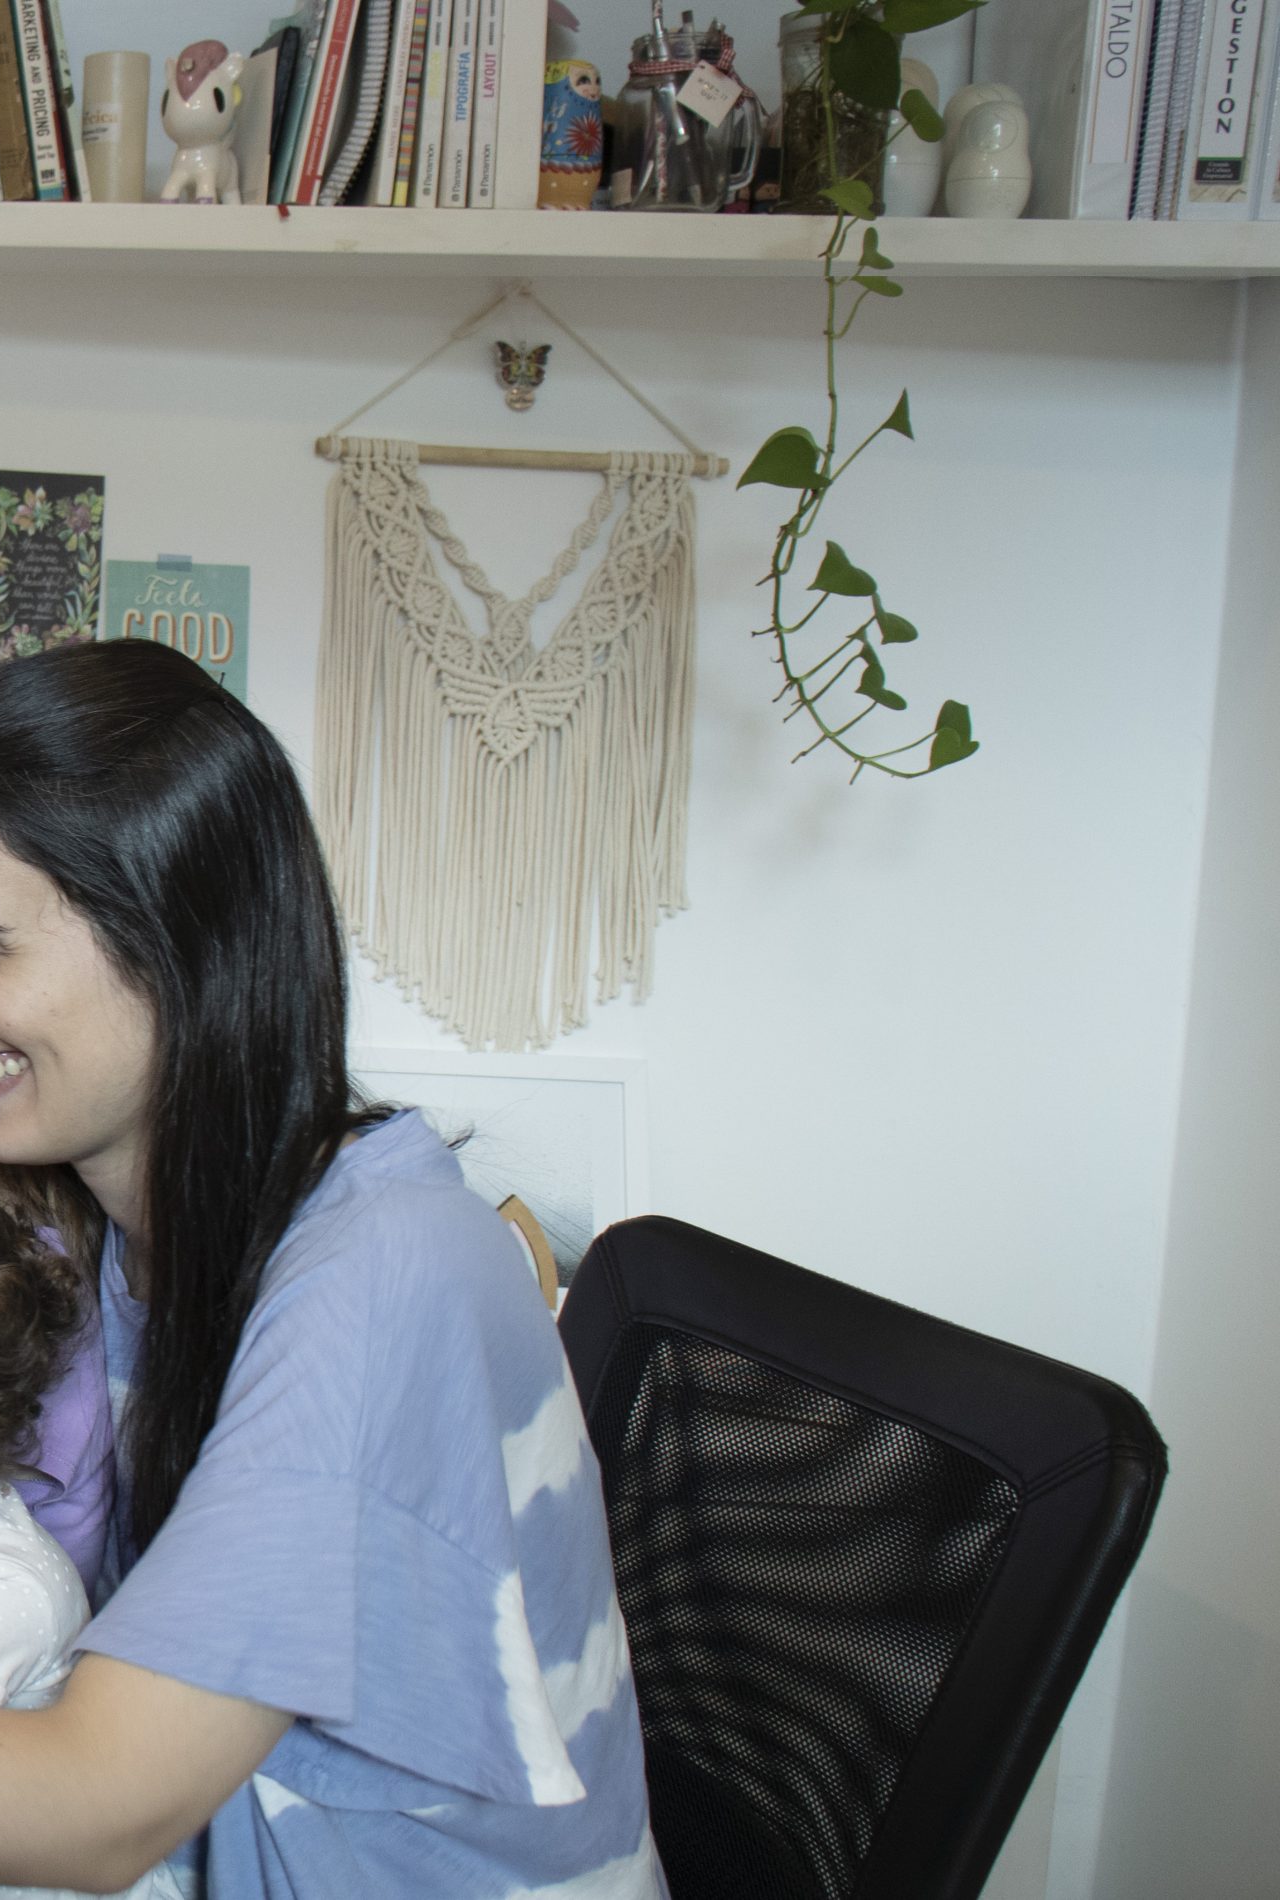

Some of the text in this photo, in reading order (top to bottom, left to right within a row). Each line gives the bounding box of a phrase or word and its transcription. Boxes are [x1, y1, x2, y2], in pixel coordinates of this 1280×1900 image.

[30, 66, 42, 83] AND
[456, 52, 470, 122] TIPOGRAFÍA
[484, 53, 497, 98] LAYOUT
[31, 89, 50, 137] PRICING
[136, 575, 209, 608] Feels
